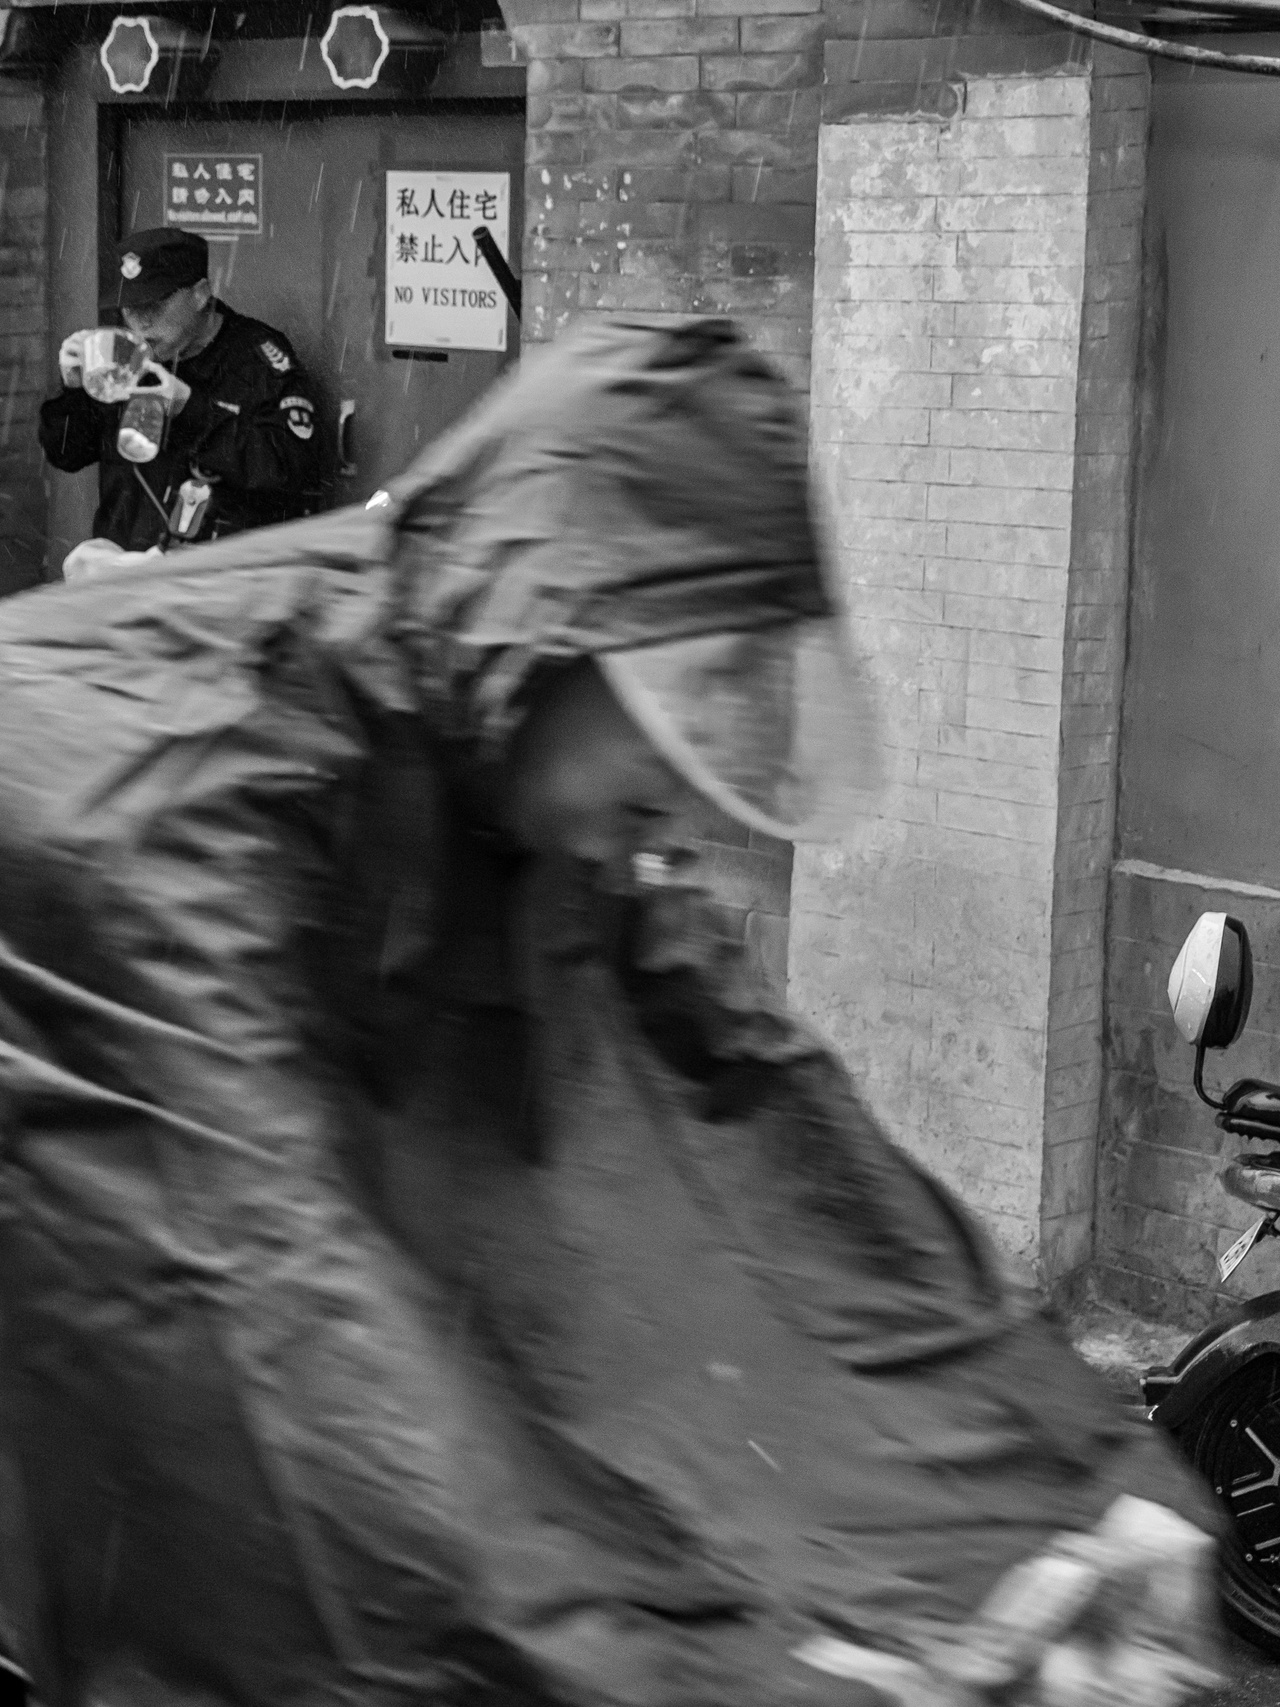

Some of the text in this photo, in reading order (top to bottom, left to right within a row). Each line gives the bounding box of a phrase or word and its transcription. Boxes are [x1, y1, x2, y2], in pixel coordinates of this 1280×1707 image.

[396, 187, 498, 221] 私人住宅
[394, 285, 498, 309] NO VISITORS
